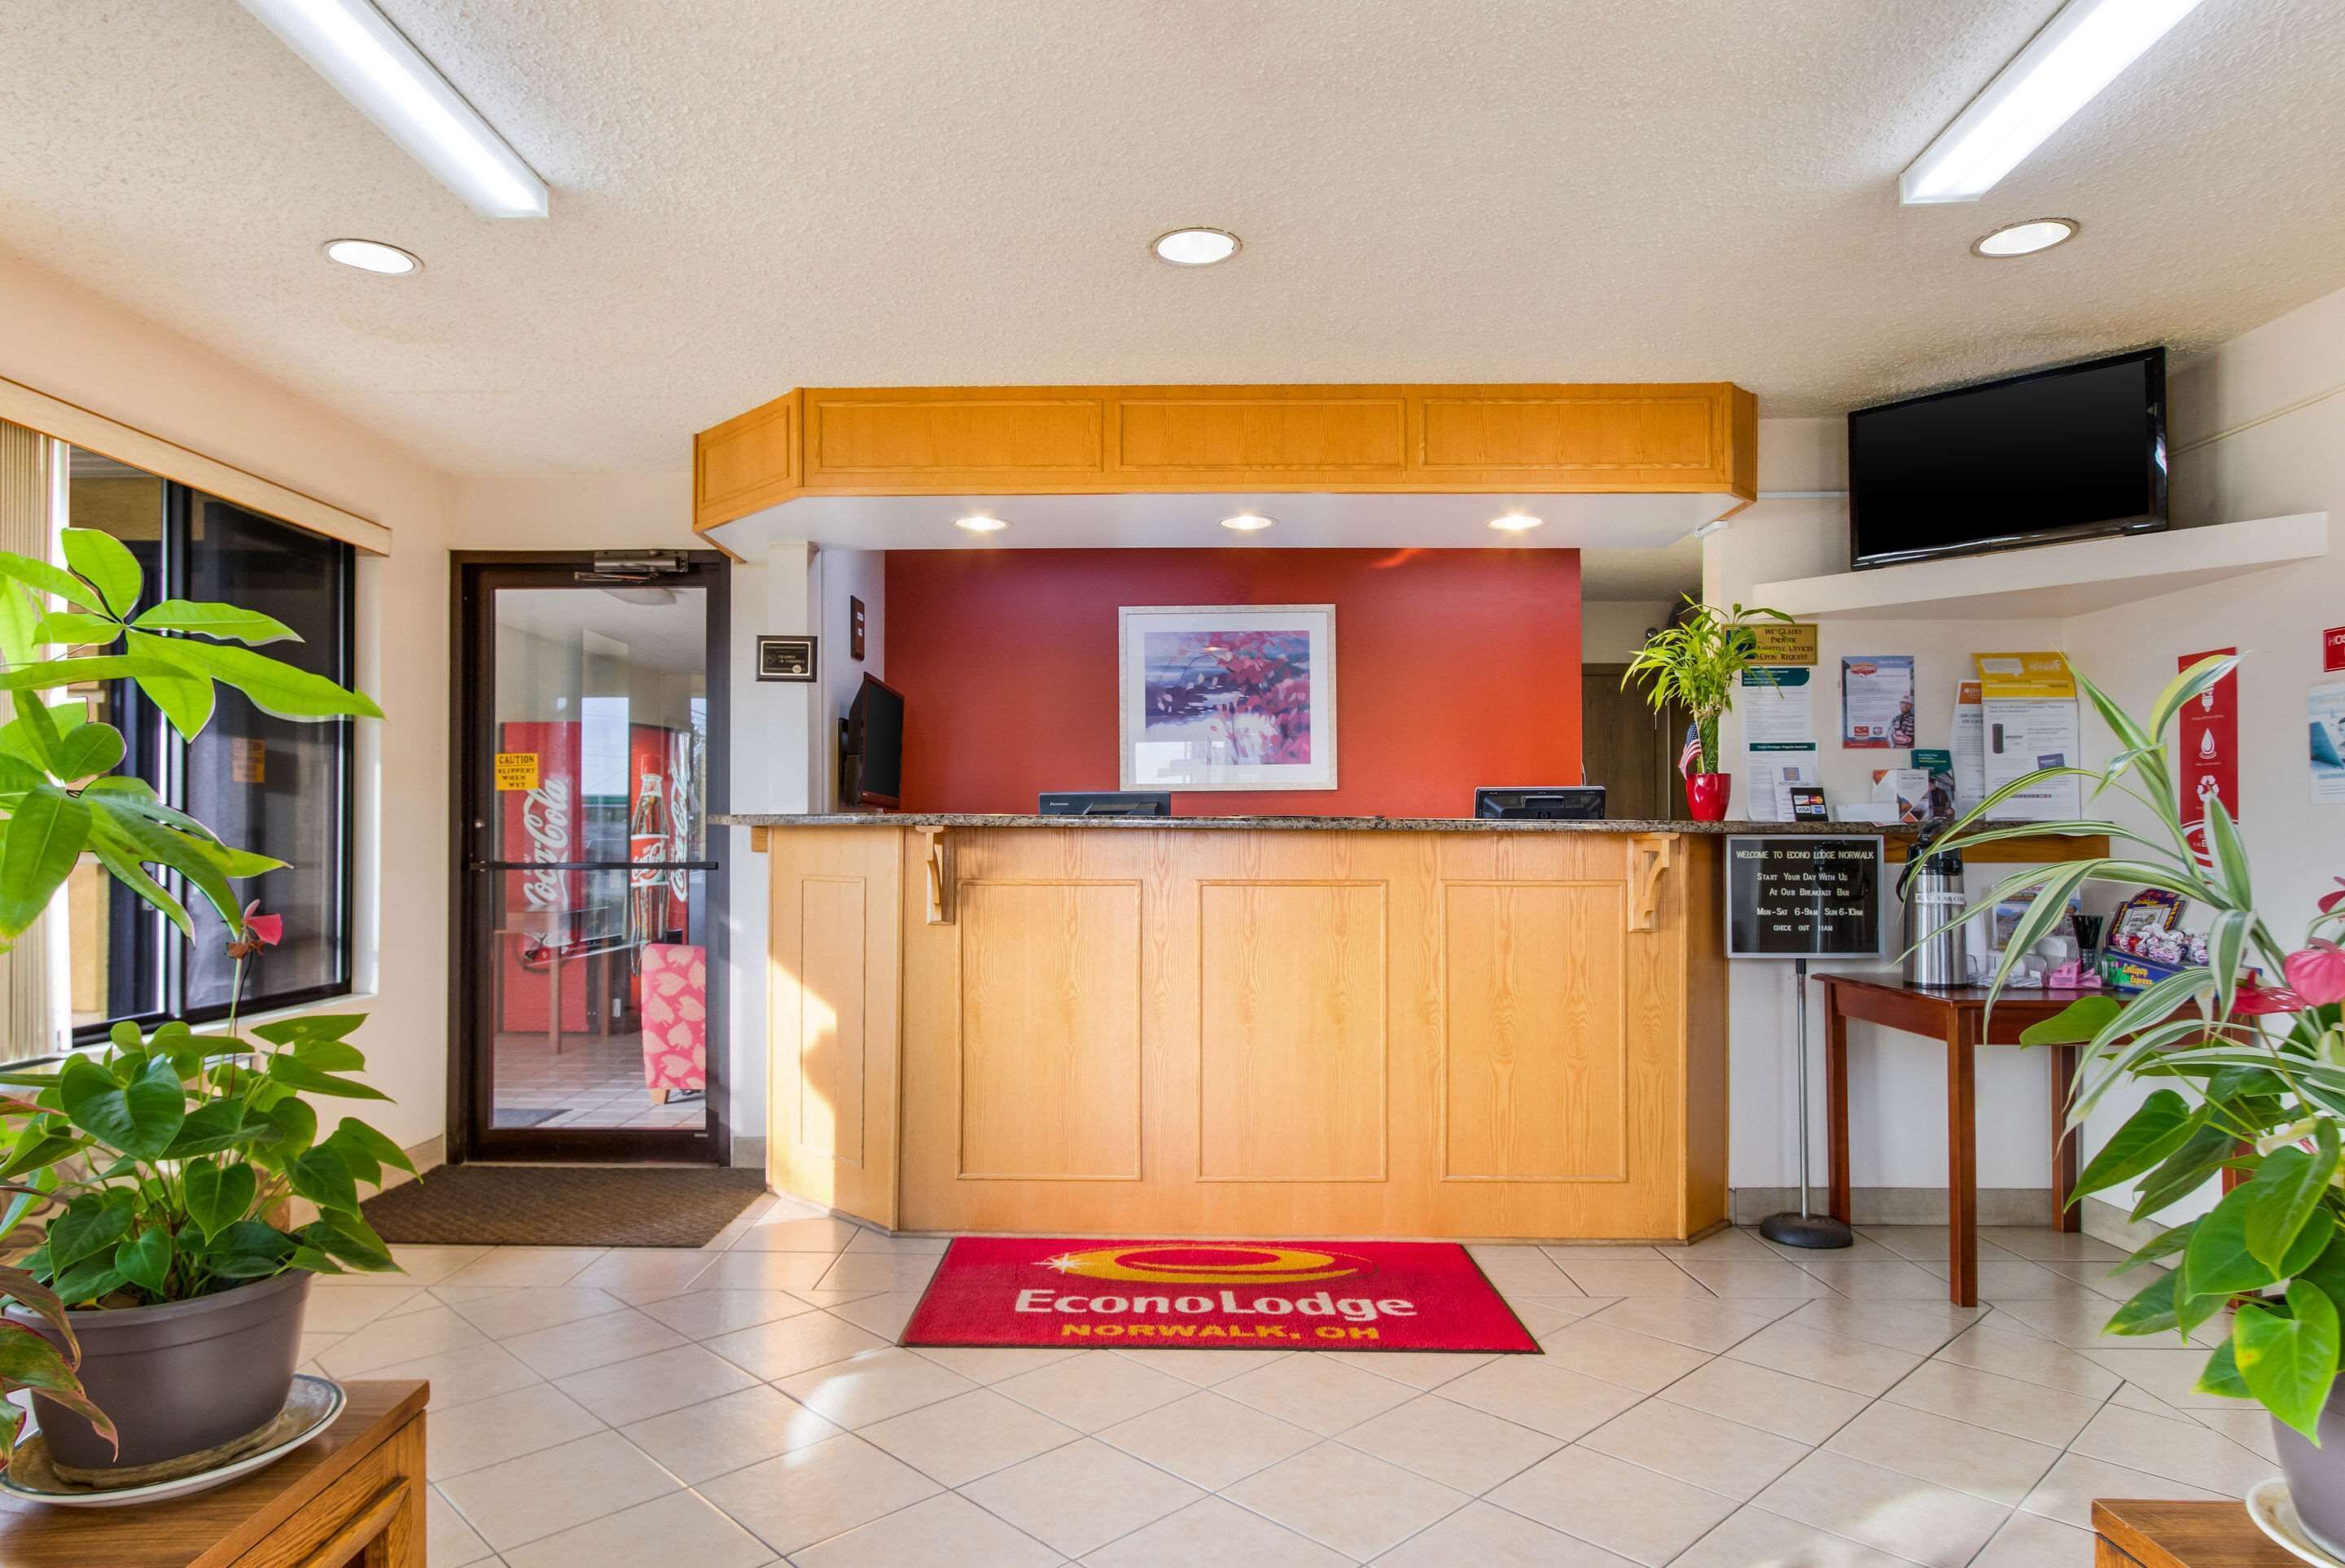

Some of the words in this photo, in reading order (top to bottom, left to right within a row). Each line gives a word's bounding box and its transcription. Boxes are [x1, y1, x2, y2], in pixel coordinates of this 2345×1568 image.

[498, 755, 534, 764] CAUTION
[1736, 851, 1769, 860] WELCOME
[1786, 851, 1811, 860] ECONO
[1813, 851, 1836, 860] LODGE
[1838, 851, 1874, 860] NORWALK
[2123, 962, 2148, 977] Lollipop
[2130, 975, 2153, 986] Express
[1061, 1324, 1300, 1340] NORWALK,
[1315, 1326, 1380, 1340] OH
